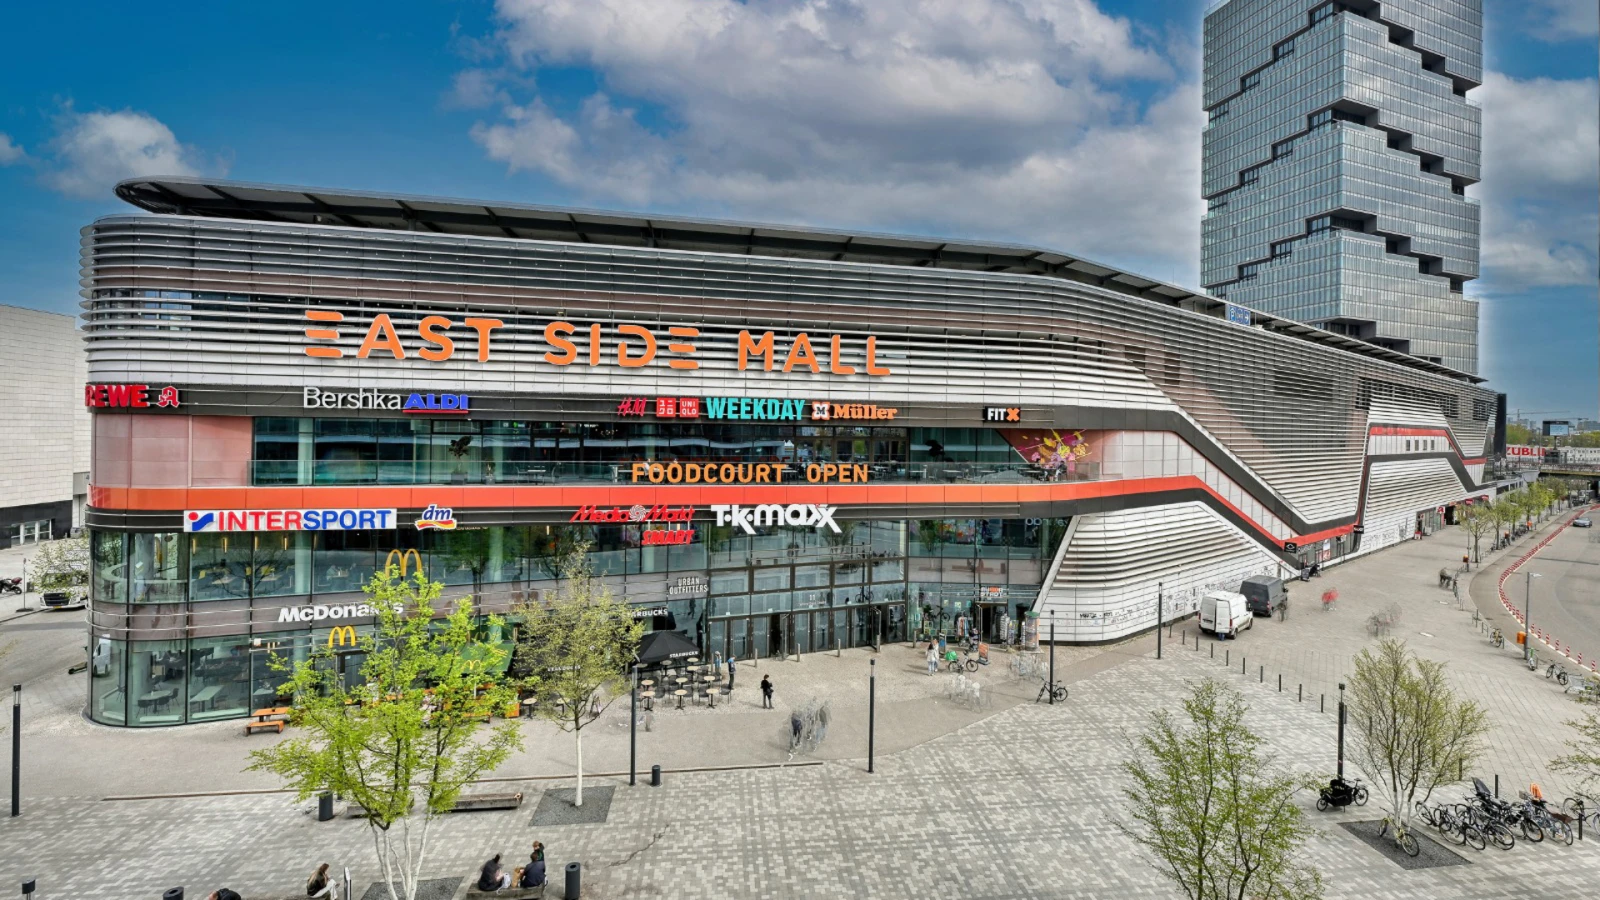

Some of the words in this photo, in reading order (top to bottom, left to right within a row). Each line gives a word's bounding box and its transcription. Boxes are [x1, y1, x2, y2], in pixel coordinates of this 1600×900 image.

[305, 310, 504, 363] EAST
[544, 321, 700, 370] SIDE
[738, 329, 891, 376] MALL
[85, 384, 150, 408] REWE
[303, 386, 402, 410] Bershka
[404, 393, 469, 410] ALDI
[681, 400, 696, 408] UNI
[617, 397, 648, 417] H&M
[681, 408, 697, 416] QLO
[706, 397, 806, 420] WEEKDAY
[833, 403, 898, 420] Müller
[632, 463, 787, 483] FOODCOURT
[806, 463, 869, 483] OPEN
[218, 509, 392, 531] INTERSPORT
[423, 505, 452, 520] dm
[641, 529, 695, 545] SMART
[669, 584, 708, 595] OUTFITTERS
[677, 577, 700, 587] URBAN
[278, 600, 404, 623] McDona's
